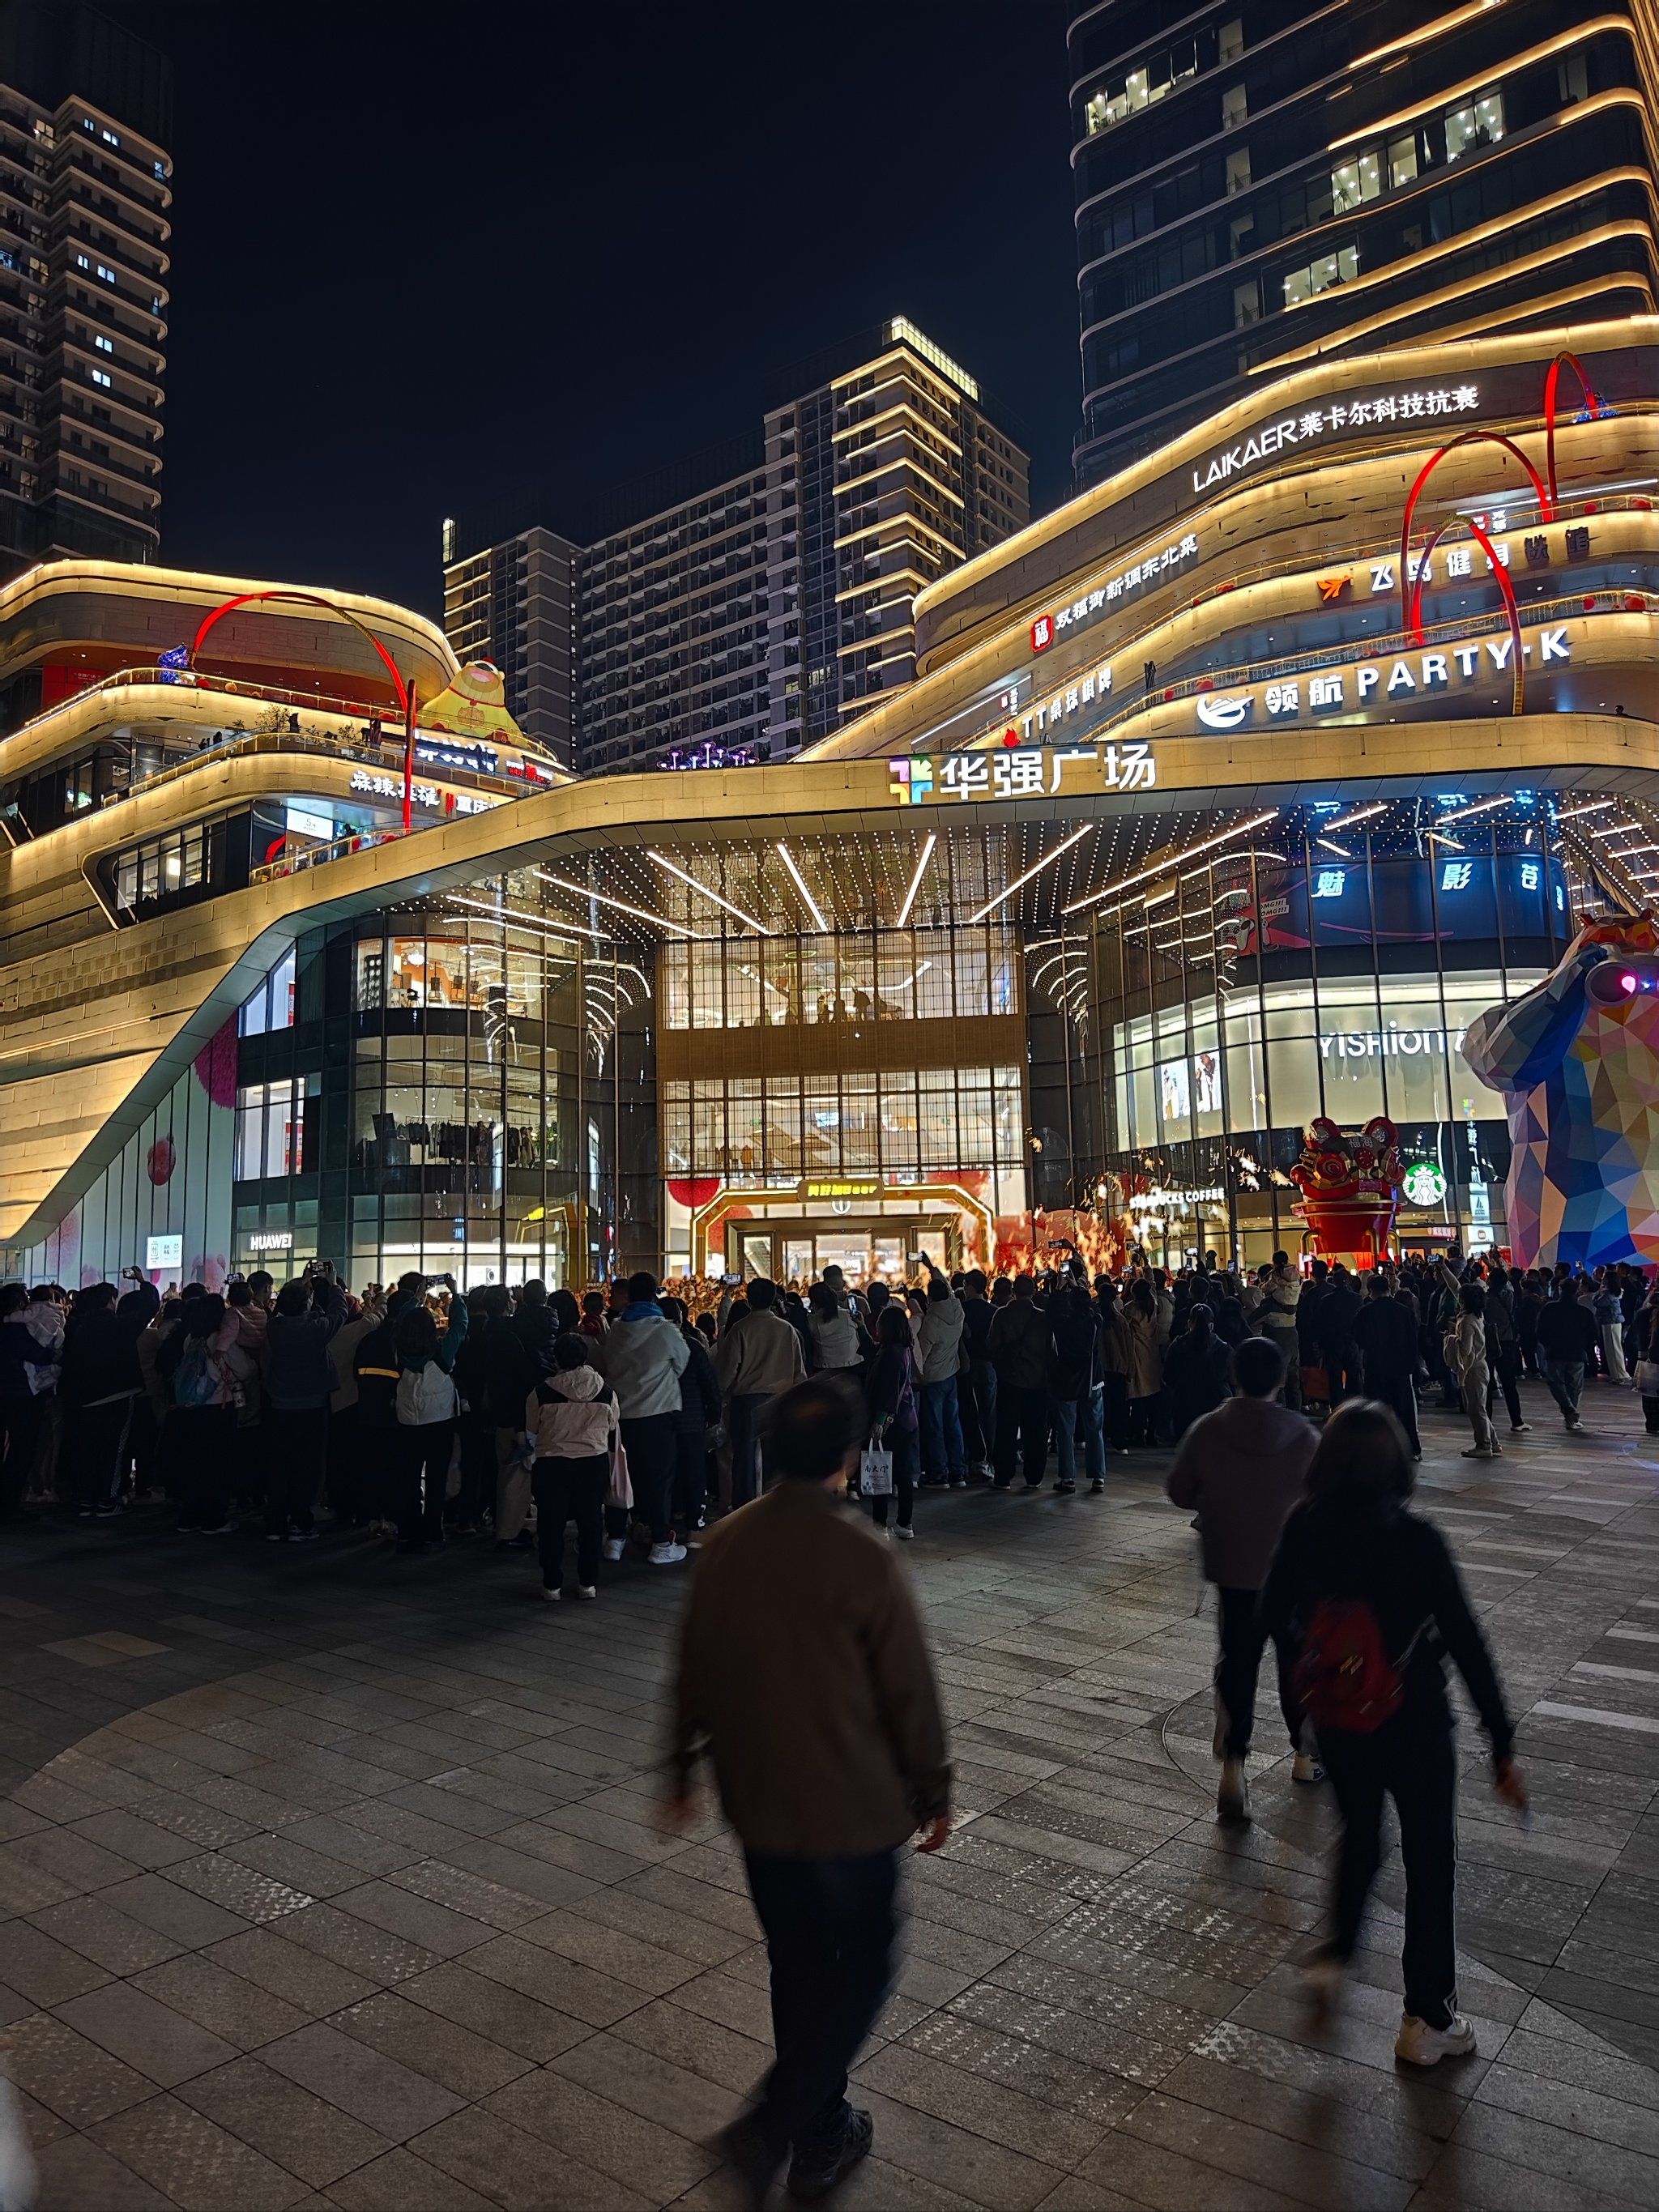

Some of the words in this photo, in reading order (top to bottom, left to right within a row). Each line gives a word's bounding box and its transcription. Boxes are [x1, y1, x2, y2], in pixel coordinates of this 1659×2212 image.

[1299, 385, 1480, 441] 莱卡尔科技抗衰
[1265, 675, 1344, 714] 领航
[940, 744, 1156, 800] 华强广场
[456, 795, 500, 814] 重庆
[1185, 1187, 1225, 1203] COFFEE
[250, 1234, 292, 1251] HUAWEI
